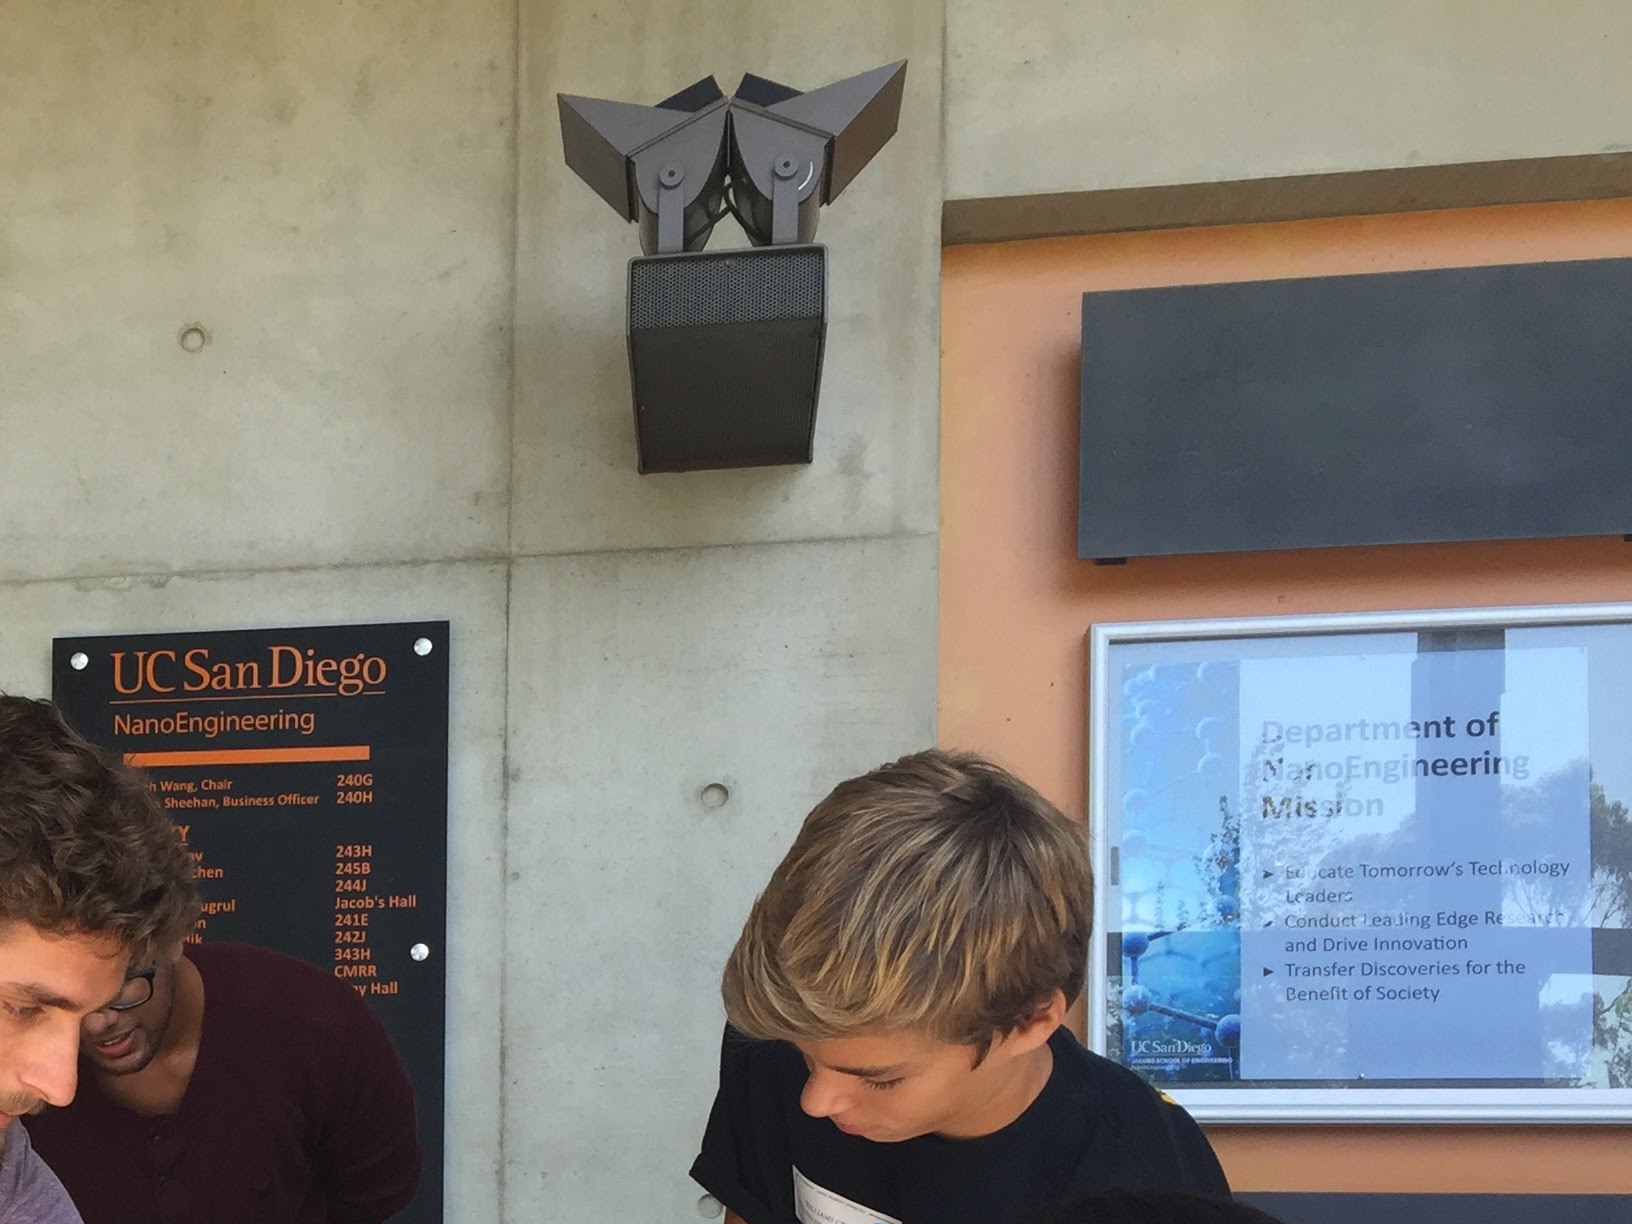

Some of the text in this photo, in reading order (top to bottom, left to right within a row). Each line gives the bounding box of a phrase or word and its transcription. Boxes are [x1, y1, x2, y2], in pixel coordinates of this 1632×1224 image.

[110, 645, 387, 696] UC San Diego
[114, 709, 315, 738] NanoEngineering
[1262, 711, 1500, 748] Department of
[1262, 750, 1531, 784] NanoEngineering
[160, 781, 198, 793] Wang,
[201, 779, 233, 791] Chair
[336, 773, 374, 787] 240G
[164, 797, 219, 809] Sheehan,
[223, 796, 274, 807] Business
[277, 793, 320, 806] Officer
[336, 791, 373, 804] 240H
[1262, 795, 1384, 819] Mission
[335, 845, 372, 858] 243H
[335, 862, 371, 875] 245B
[1286, 864, 1354, 880] Edcate
[335, 879, 366, 892] 244J
[335, 896, 386, 909] Jacob's
[389, 894, 417, 908] Hall
[1286, 889, 1353, 904] Leaders
[334, 914, 369, 926] 241E
[1284, 914, 1356, 929] Conduct
[1436, 911, 1479, 929] Edge
[334, 931, 366, 943] 242J
[1285, 935, 1469, 952] and Drive Innovation
[334, 948, 371, 960] 343H
[334, 965, 377, 977] CMRR
[1286, 959, 1526, 977] Transfer Discoveries for the
[371, 981, 398, 994] Hall
[1286, 984, 1440, 1003] Benefit of Society
[1131, 1039, 1212, 1056] UC San Diego
